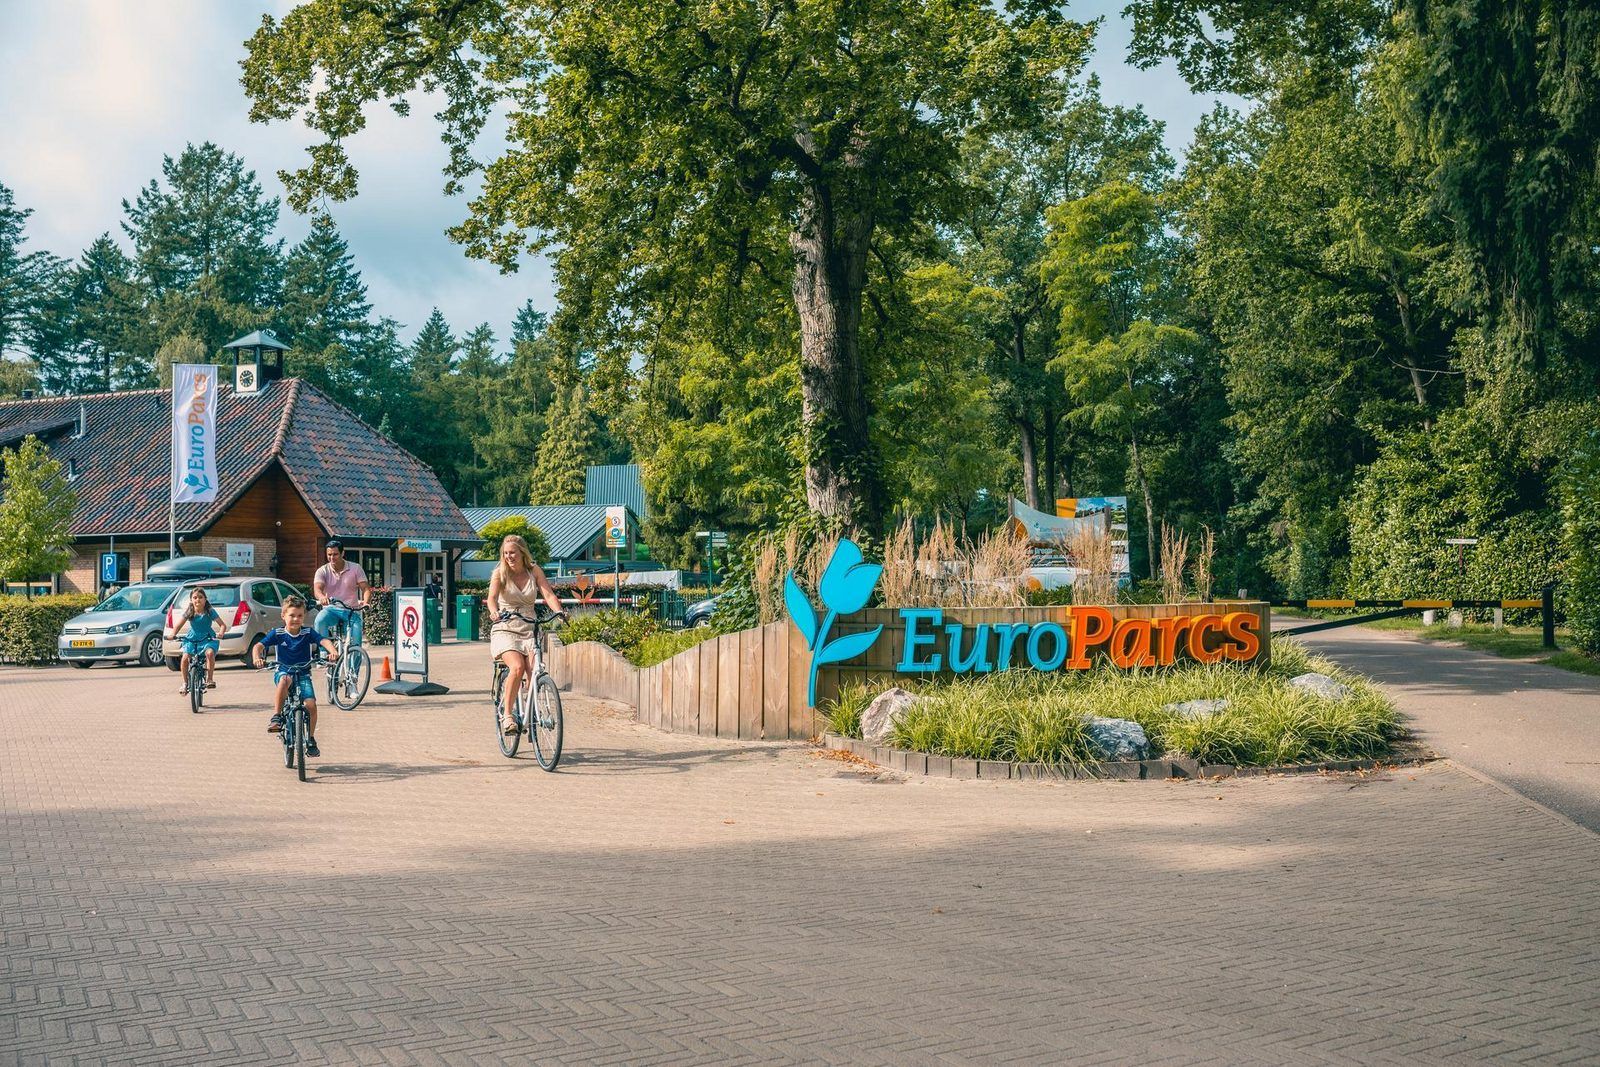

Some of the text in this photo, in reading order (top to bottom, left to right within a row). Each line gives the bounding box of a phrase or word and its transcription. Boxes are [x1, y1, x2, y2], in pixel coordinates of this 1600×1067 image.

[188, 373, 207, 472] EuroParcs
[105, 556, 113, 570] P
[408, 540, 433, 551] Receptie
[896, 606, 1261, 673] EuroParcs
